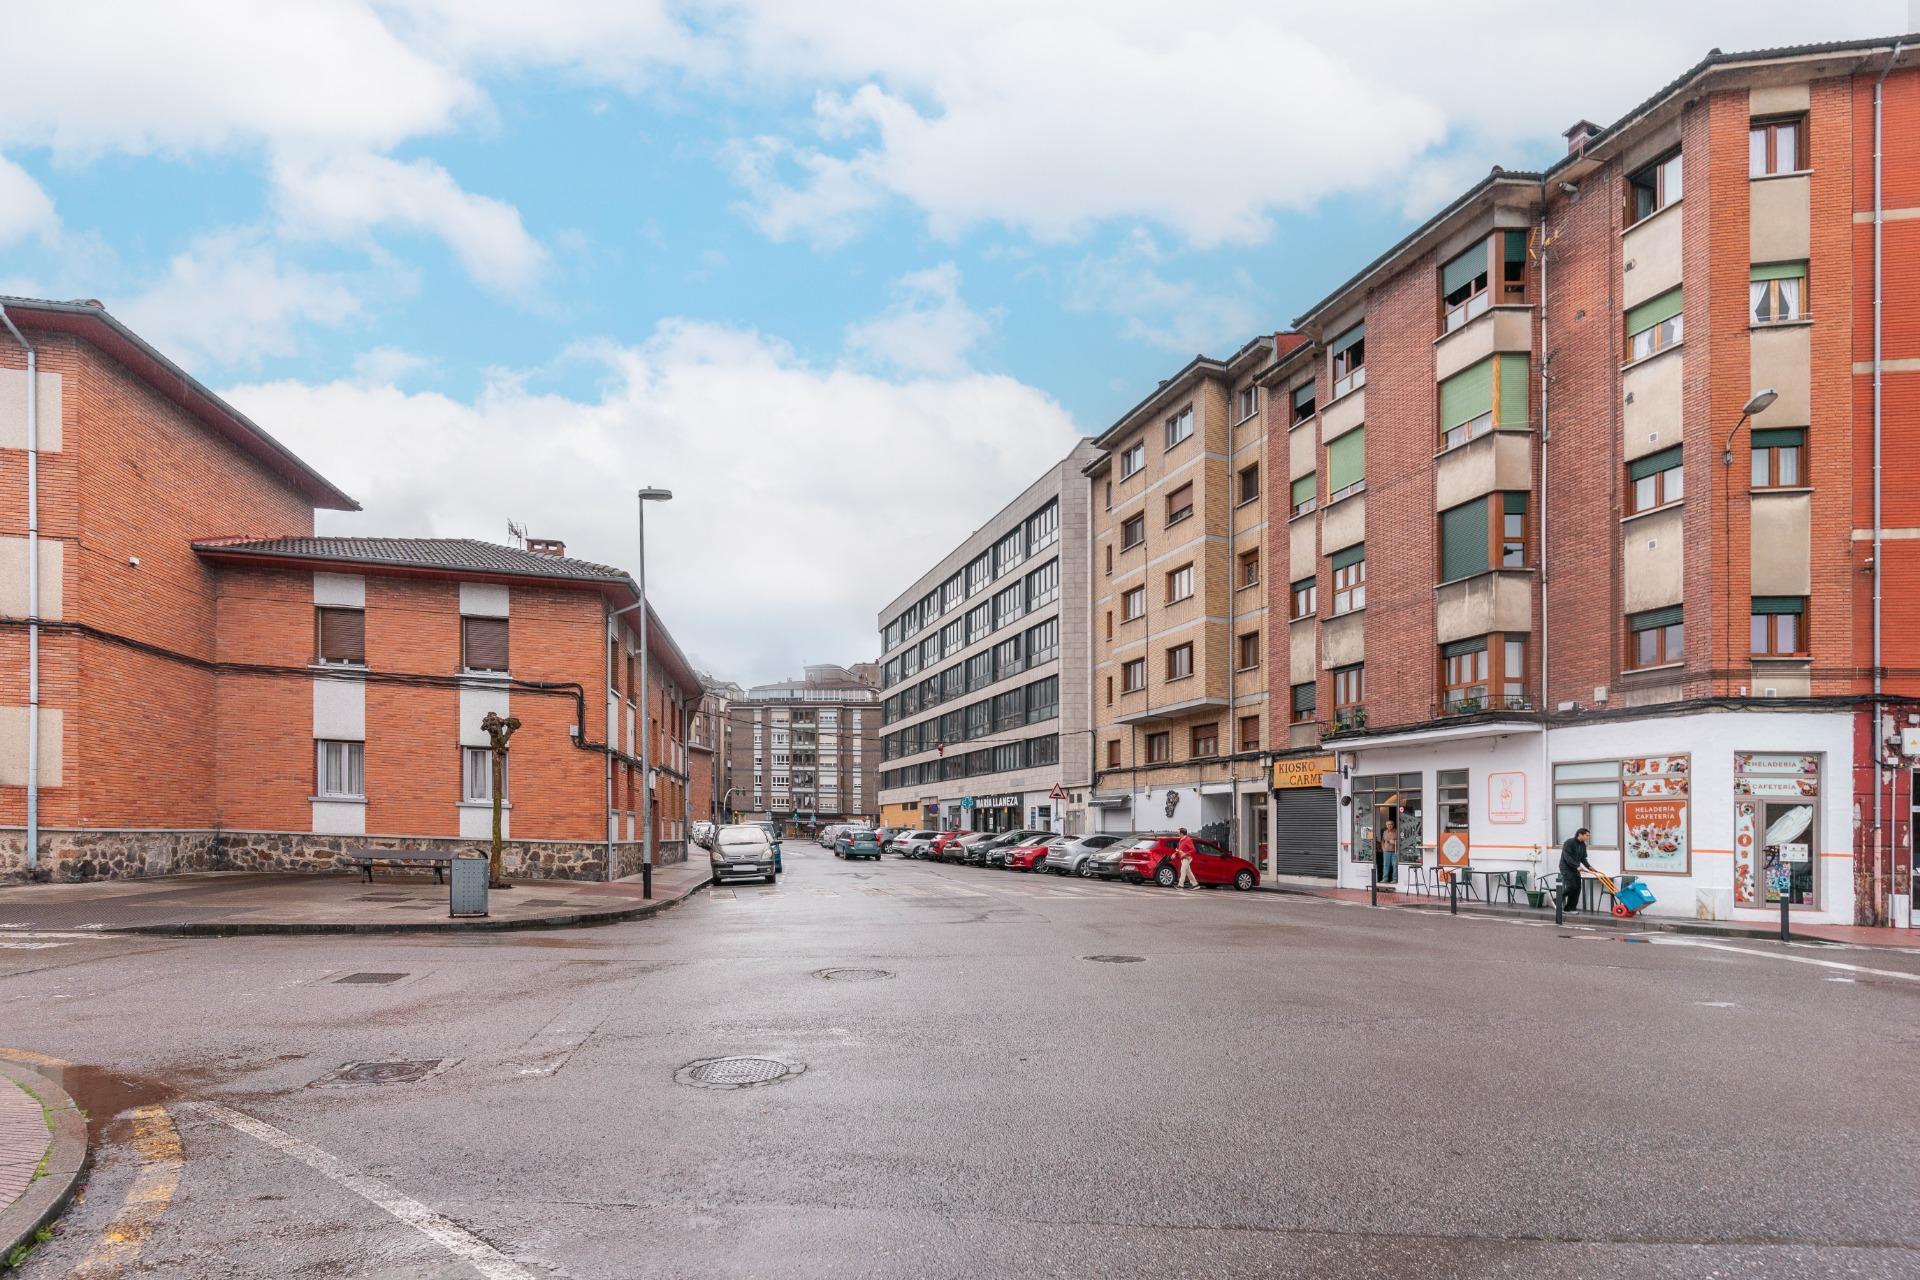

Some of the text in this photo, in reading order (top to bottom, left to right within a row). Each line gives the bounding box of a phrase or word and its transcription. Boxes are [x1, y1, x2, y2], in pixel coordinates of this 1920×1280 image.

[1279, 761, 1315, 774] KIOSKO
[1289, 773, 1323, 786] CARME
[992, 795, 1018, 807] LLANEZA
